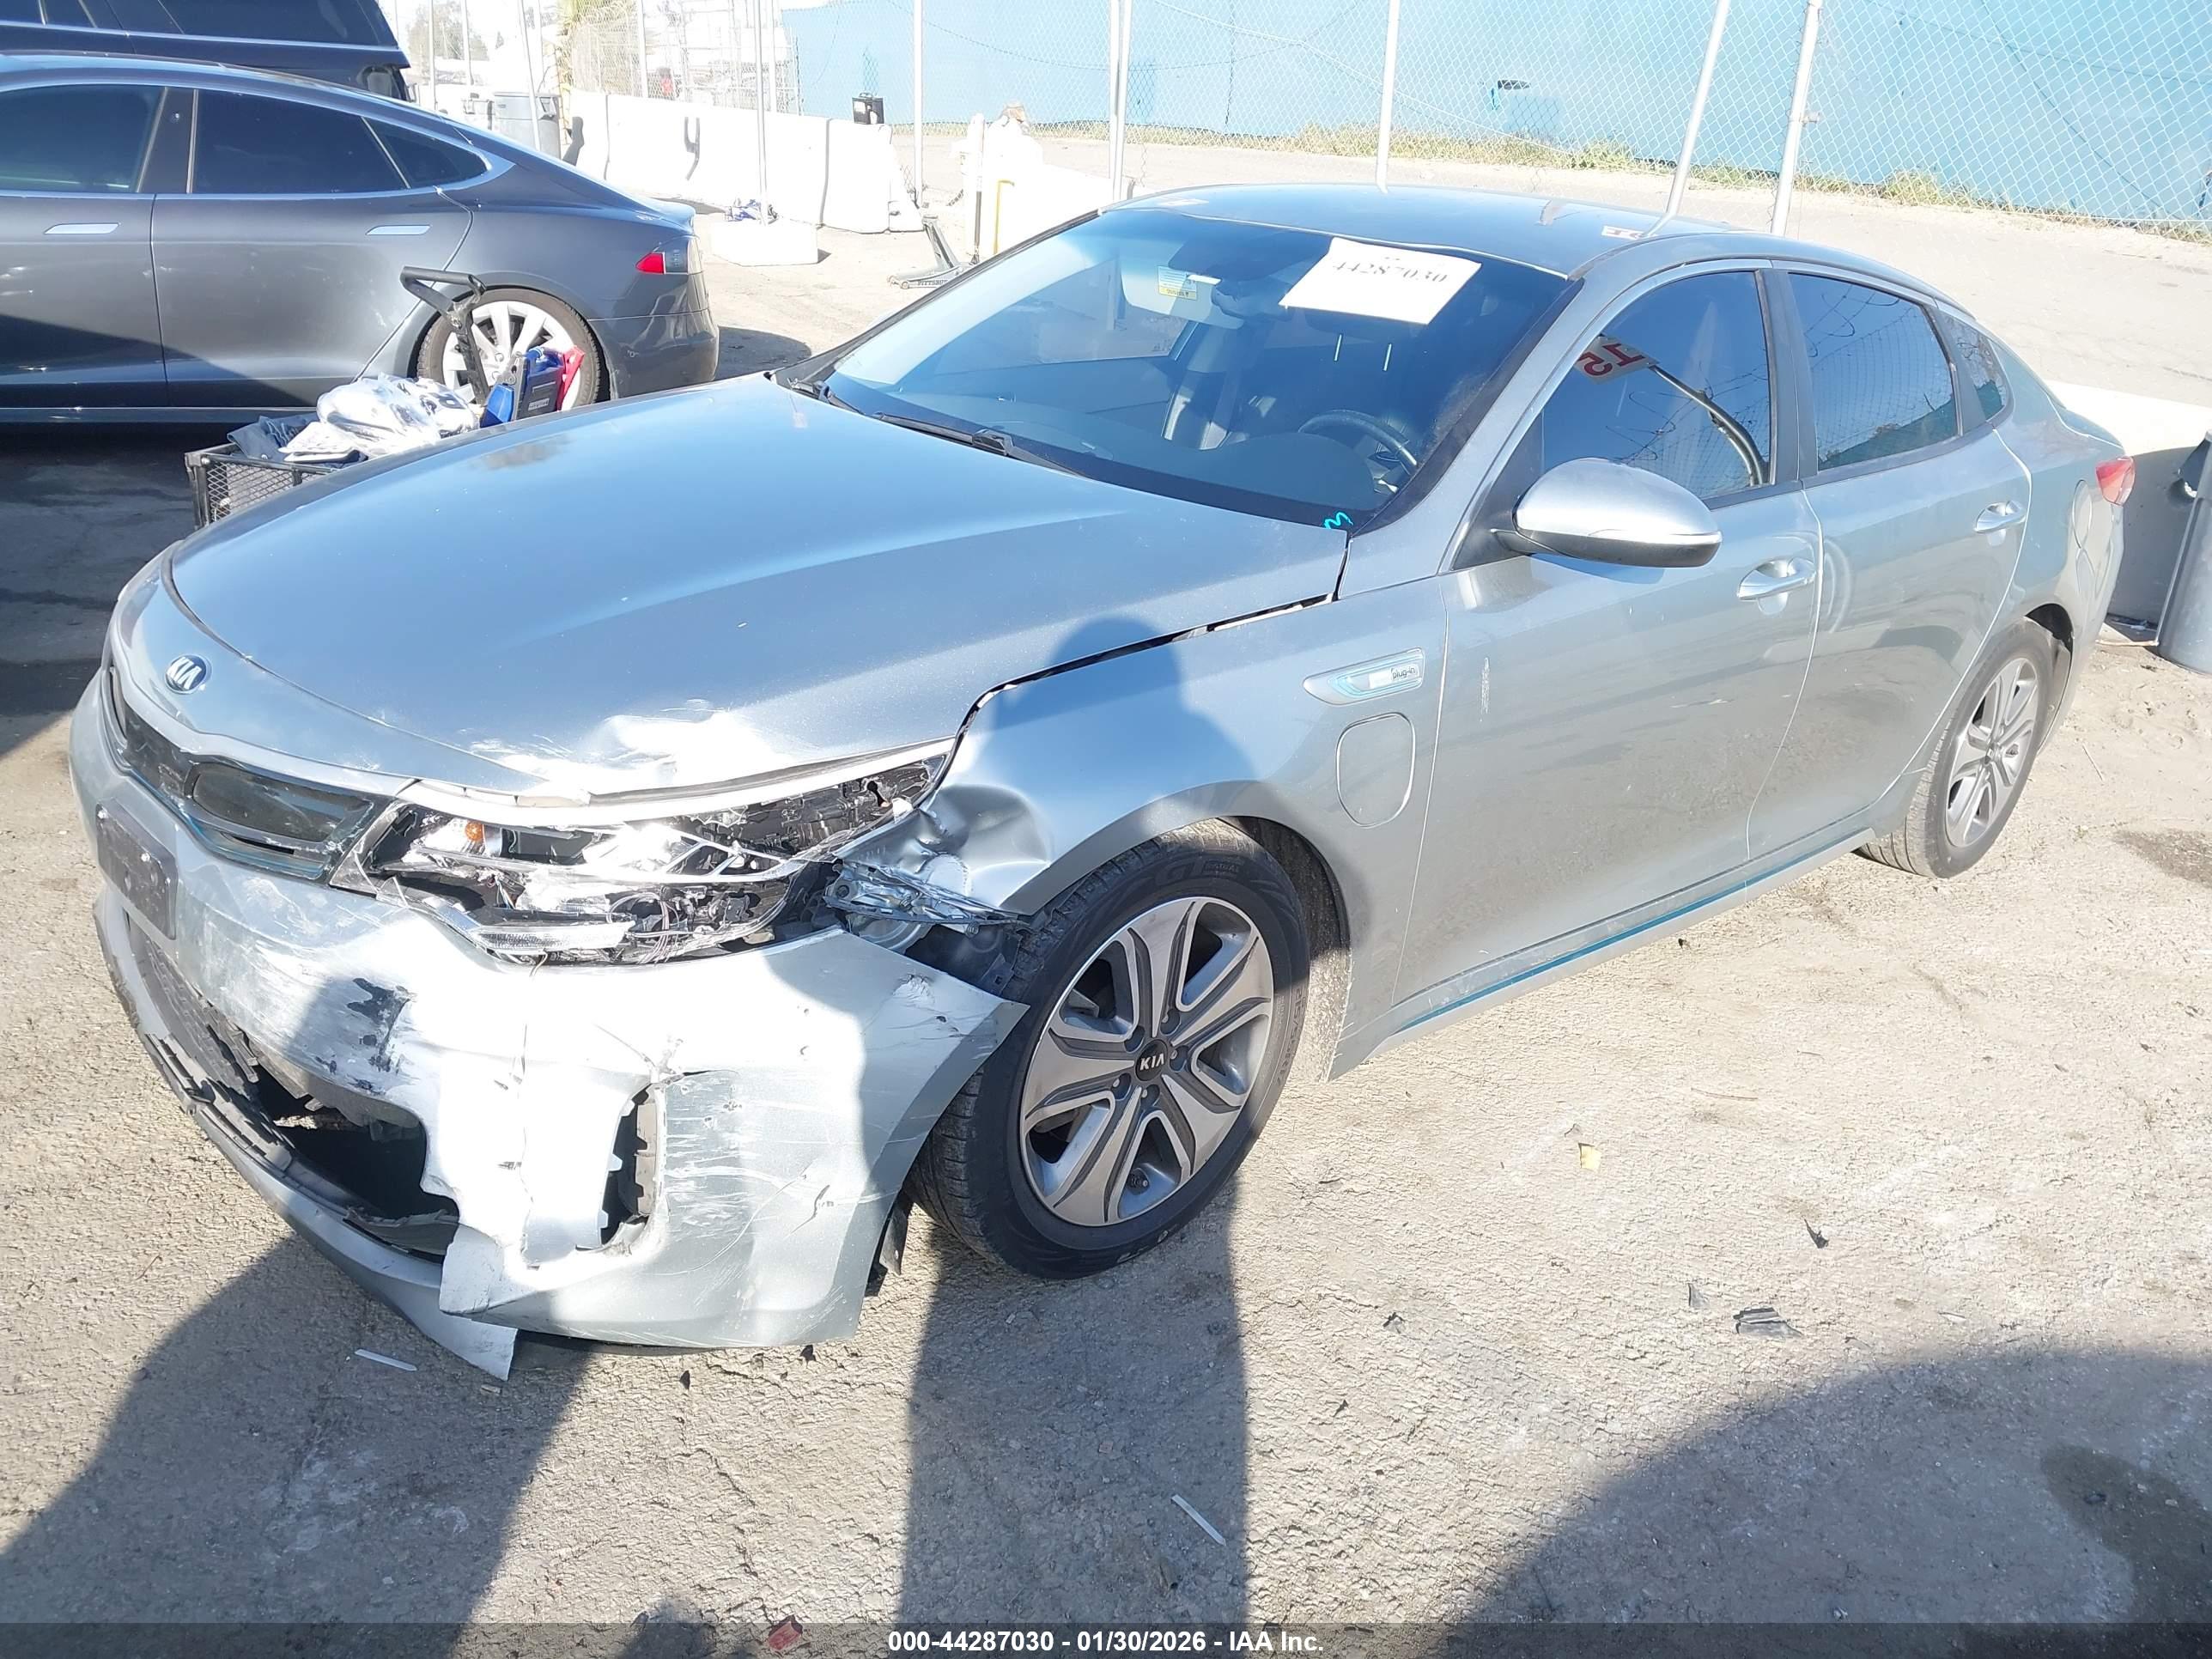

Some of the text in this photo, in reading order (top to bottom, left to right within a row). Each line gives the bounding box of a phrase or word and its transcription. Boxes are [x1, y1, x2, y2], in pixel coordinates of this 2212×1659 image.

[167, 656, 203, 690] KIA
[1392, 666, 1416, 679] plug-in
[1139, 1053, 1164, 1071] KIA
